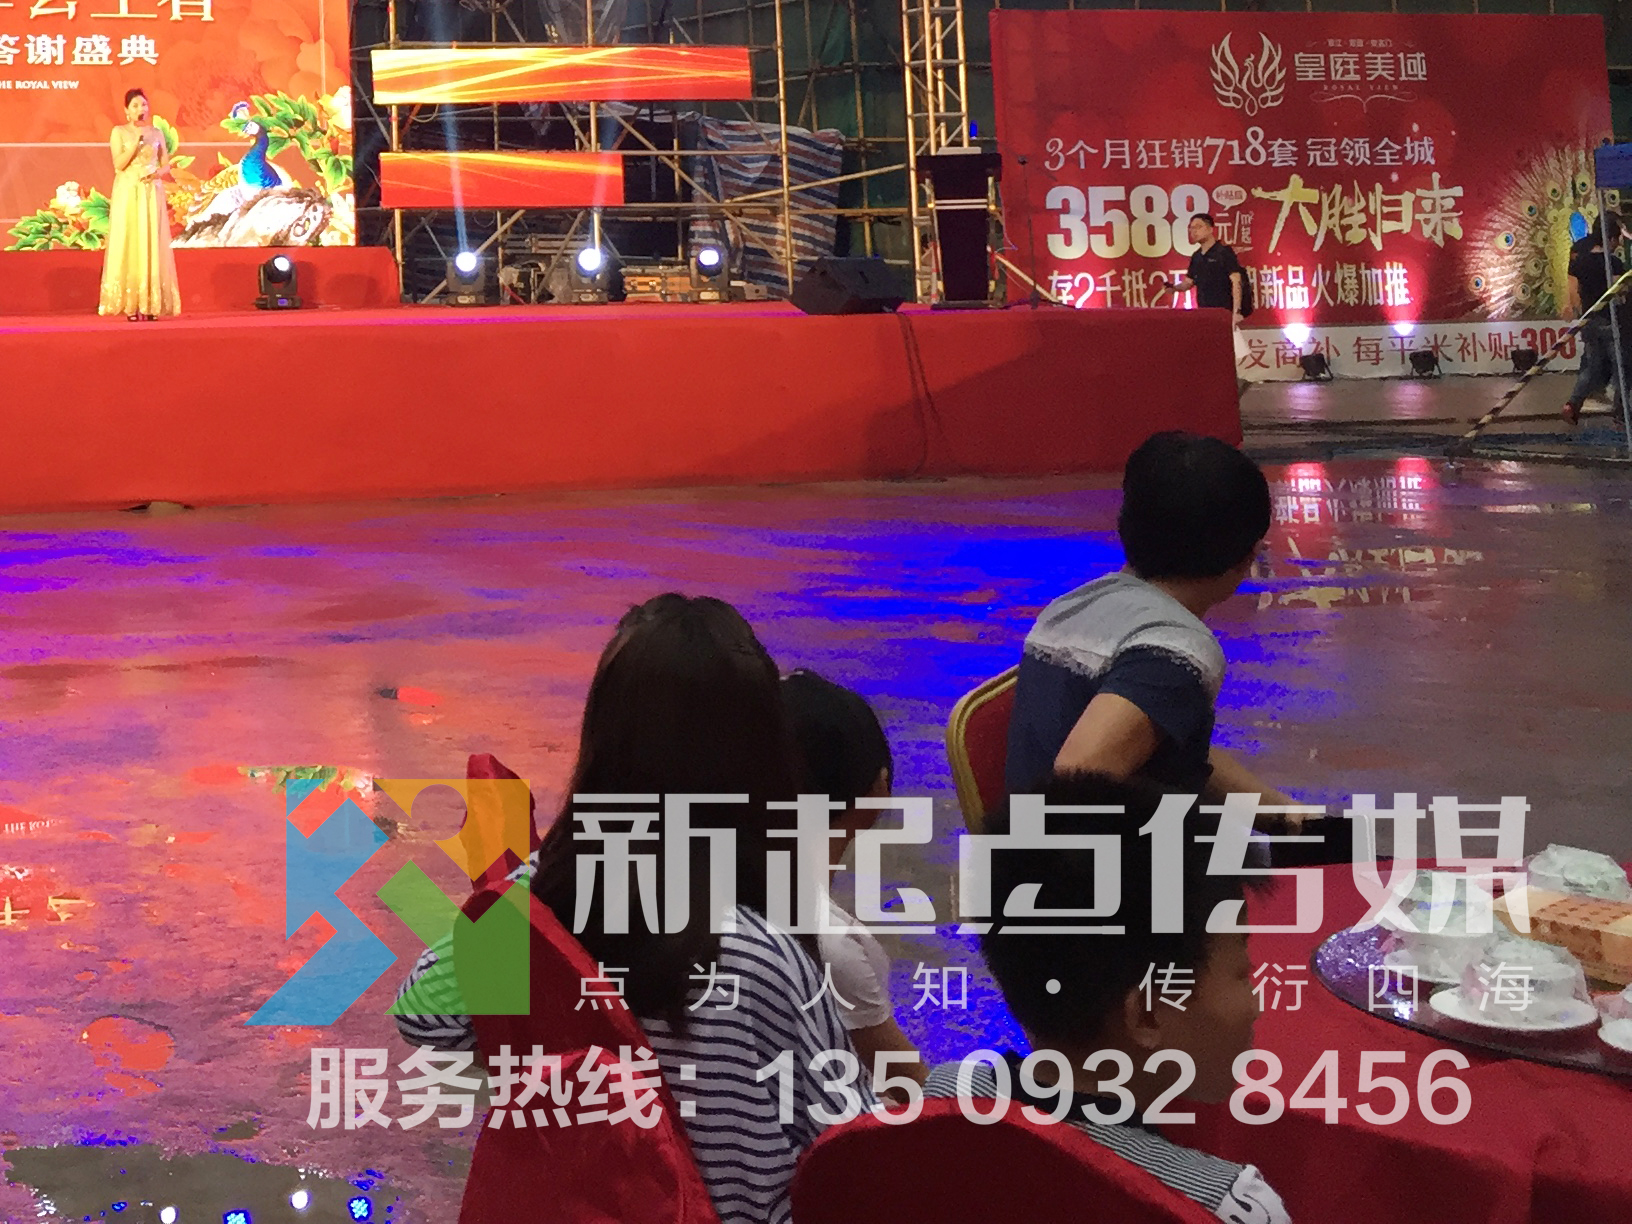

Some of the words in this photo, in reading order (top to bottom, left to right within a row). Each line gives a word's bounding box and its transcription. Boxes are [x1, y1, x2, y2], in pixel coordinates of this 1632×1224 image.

[16, 80, 49, 90] ROYAL
[52, 80, 79, 90] VIEW
[1294, 52, 1428, 82] 皇庭美域
[1044, 126, 1299, 175] 3个月狂销718套
[1307, 135, 1436, 167] 冠领全城
[1045, 184, 1211, 260] 3588
[1251, 172, 1464, 253] 大胜归来
